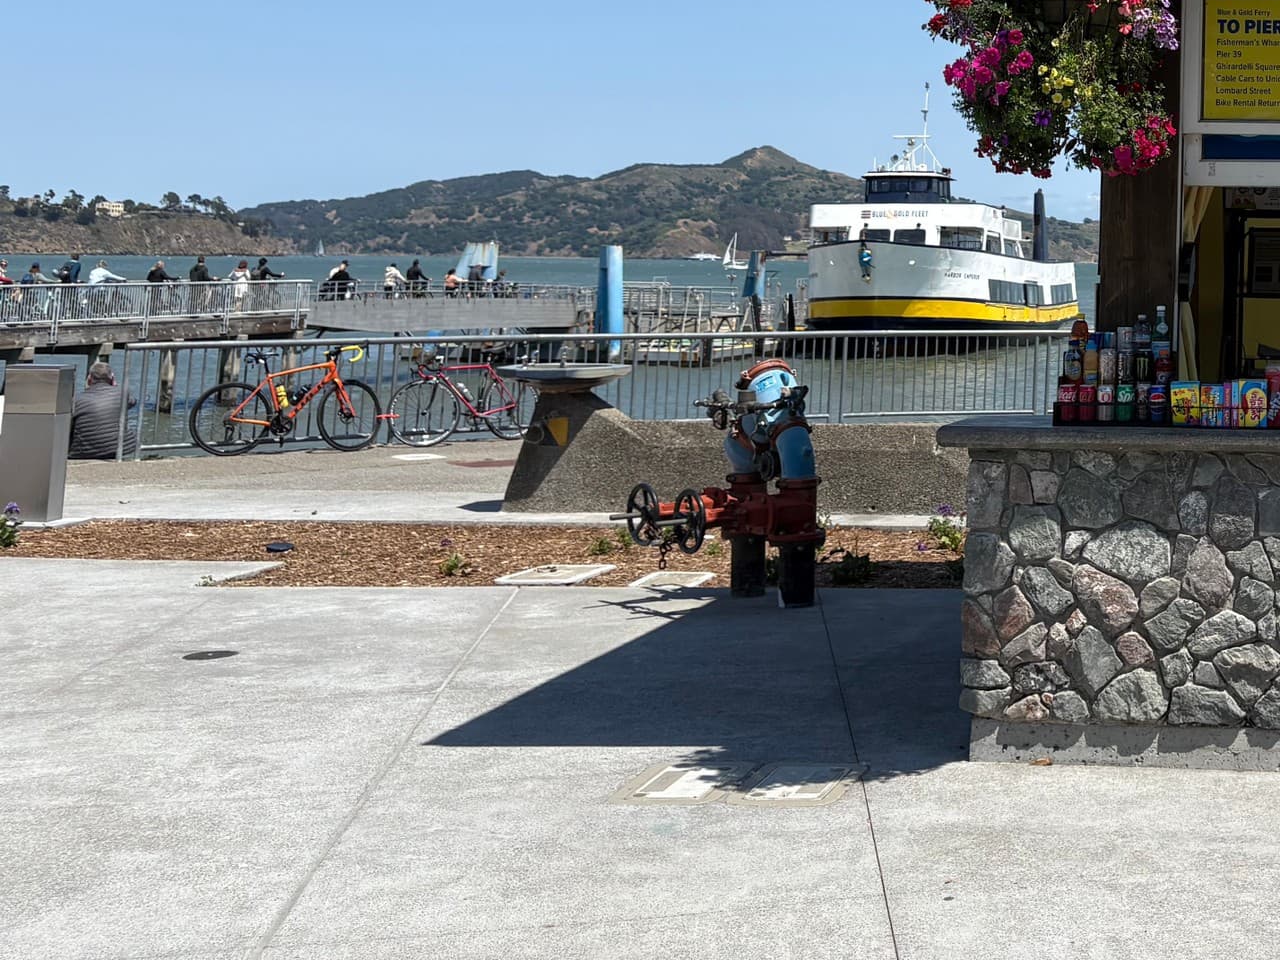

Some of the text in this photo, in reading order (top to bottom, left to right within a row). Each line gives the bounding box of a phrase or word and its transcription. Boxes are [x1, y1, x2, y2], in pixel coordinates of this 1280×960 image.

[1217, 8, 1231, 16] Blue
[1254, 9, 1271, 17] Ferry
[1217, 19, 1240, 34] TO
[1216, 38, 1259, 46] Fisherman's
[1216, 62, 1280, 72] Ghirardelli Square
[1216, 74, 1237, 82] Cable
[1216, 86, 1248, 94] Lombard
[872, 210, 887, 218] BLUE
